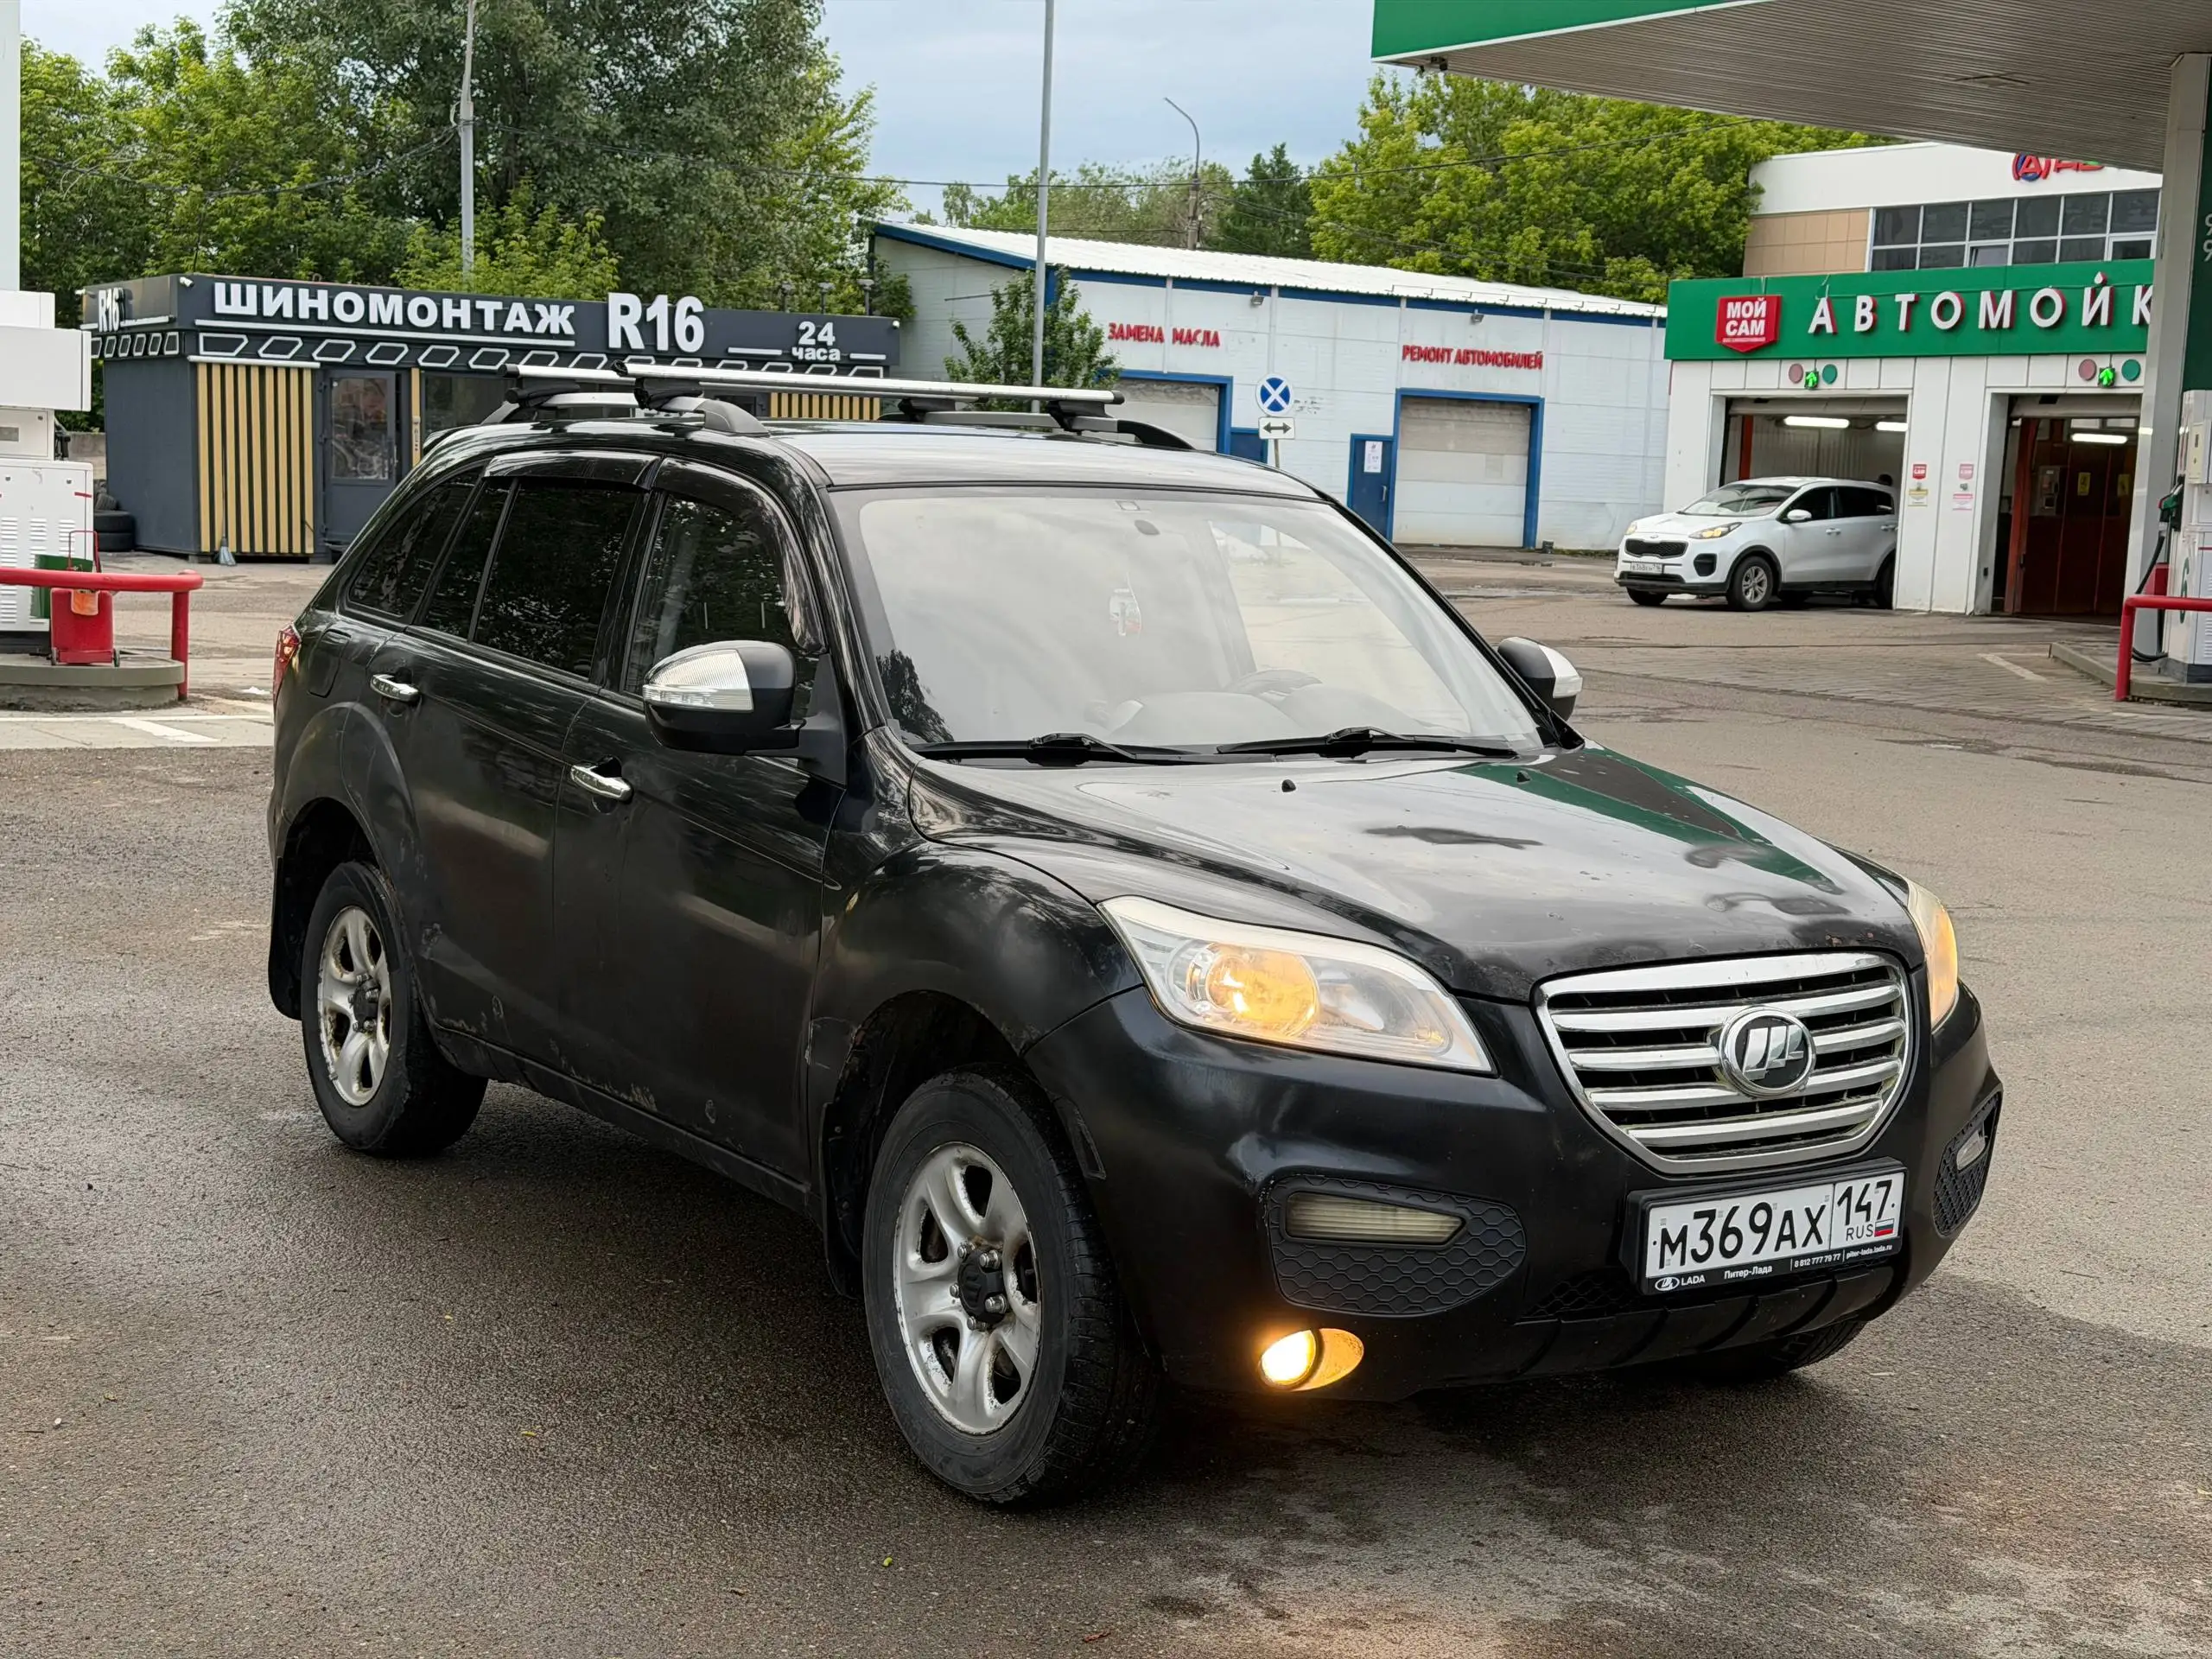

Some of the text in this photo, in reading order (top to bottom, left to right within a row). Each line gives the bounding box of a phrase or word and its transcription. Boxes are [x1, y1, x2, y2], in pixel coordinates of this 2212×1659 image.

[99, 288, 120, 333] R16
[214, 282, 575, 335] ШИНОМОНТАЖ
[1726, 297, 1767, 319] МОЙ
[607, 292, 705, 353] R16
[798, 321, 836, 346] 24
[1726, 319, 1765, 337] САМ
[1109, 322, 1221, 347] ЗАМЕНА МАСЛА
[791, 346, 841, 361] часа
[1402, 345, 1544, 371] РЕМОНТ АВТОМОБИЛЕЙ
[1658, 1179, 1893, 1270] М369АХ 147
[1846, 1224, 1874, 1242] RUS
[1811, 1255, 1823, 1265] 777
[1681, 1274, 1706, 1287] LADA
[1724, 1264, 1772, 1280] Питер-Лада
